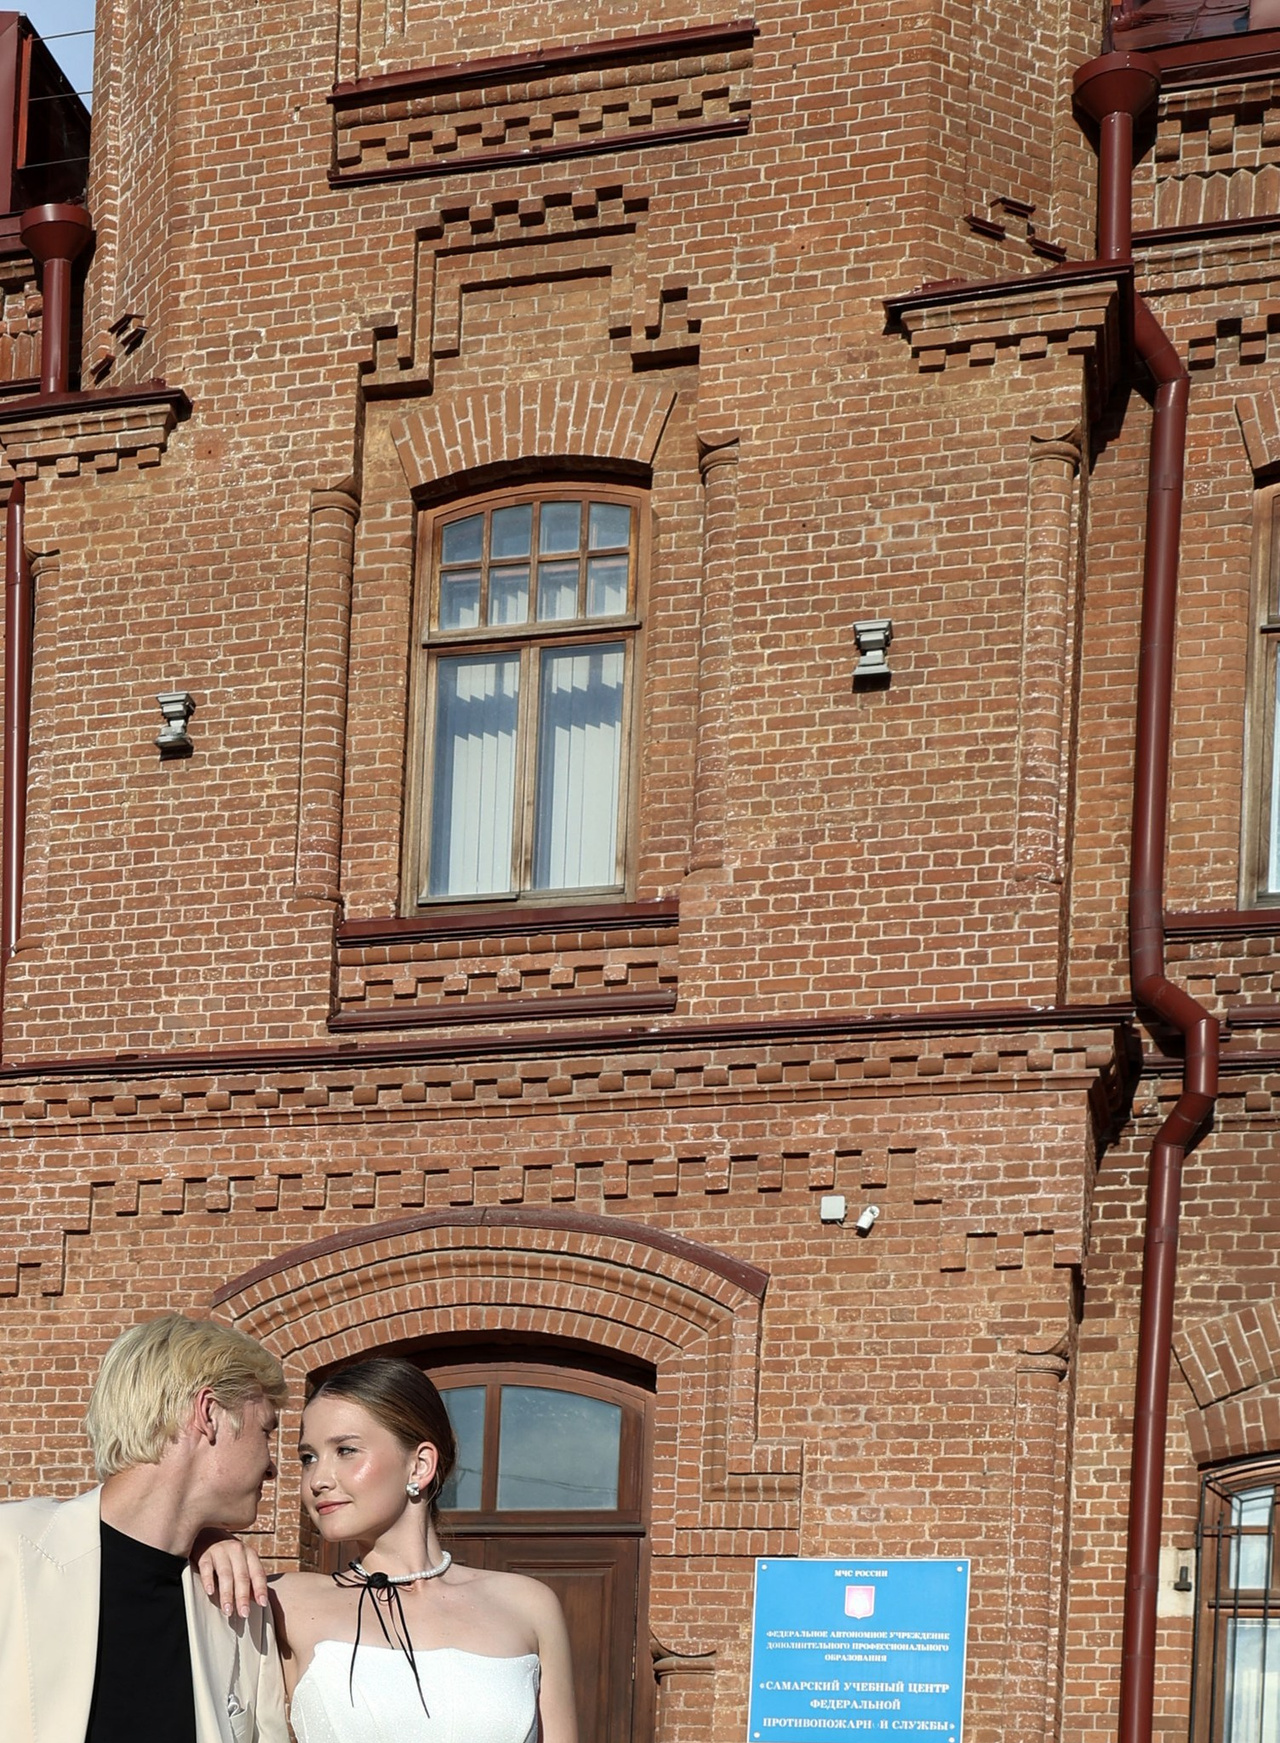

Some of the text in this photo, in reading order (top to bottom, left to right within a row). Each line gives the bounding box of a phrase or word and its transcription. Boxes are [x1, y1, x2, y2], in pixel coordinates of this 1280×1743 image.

[834, 1569, 888, 1578] МЧС РОССИИ
[766, 1630, 950, 1640] ФЕДЕРАЛЬНОЕ АВТОНОМНОЕ УЧРЕЖДЕНИЕ
[766, 1642, 949, 1652] ДОПОЛНИТЕЛЬНОГО ПРОФЕССИОНАЛЬНОГО
[824, 1653, 888, 1662] ОБРАЗОВАНИЯ
[759, 1680, 950, 1694] «САМАРСКИЙ УЧЕБНЫЙ ЦЕНТР
[809, 1698, 901, 1711] ФЕДЕРАЛЬНОЙ
[892, 1720, 956, 1731] СЛУЖБЫ»
